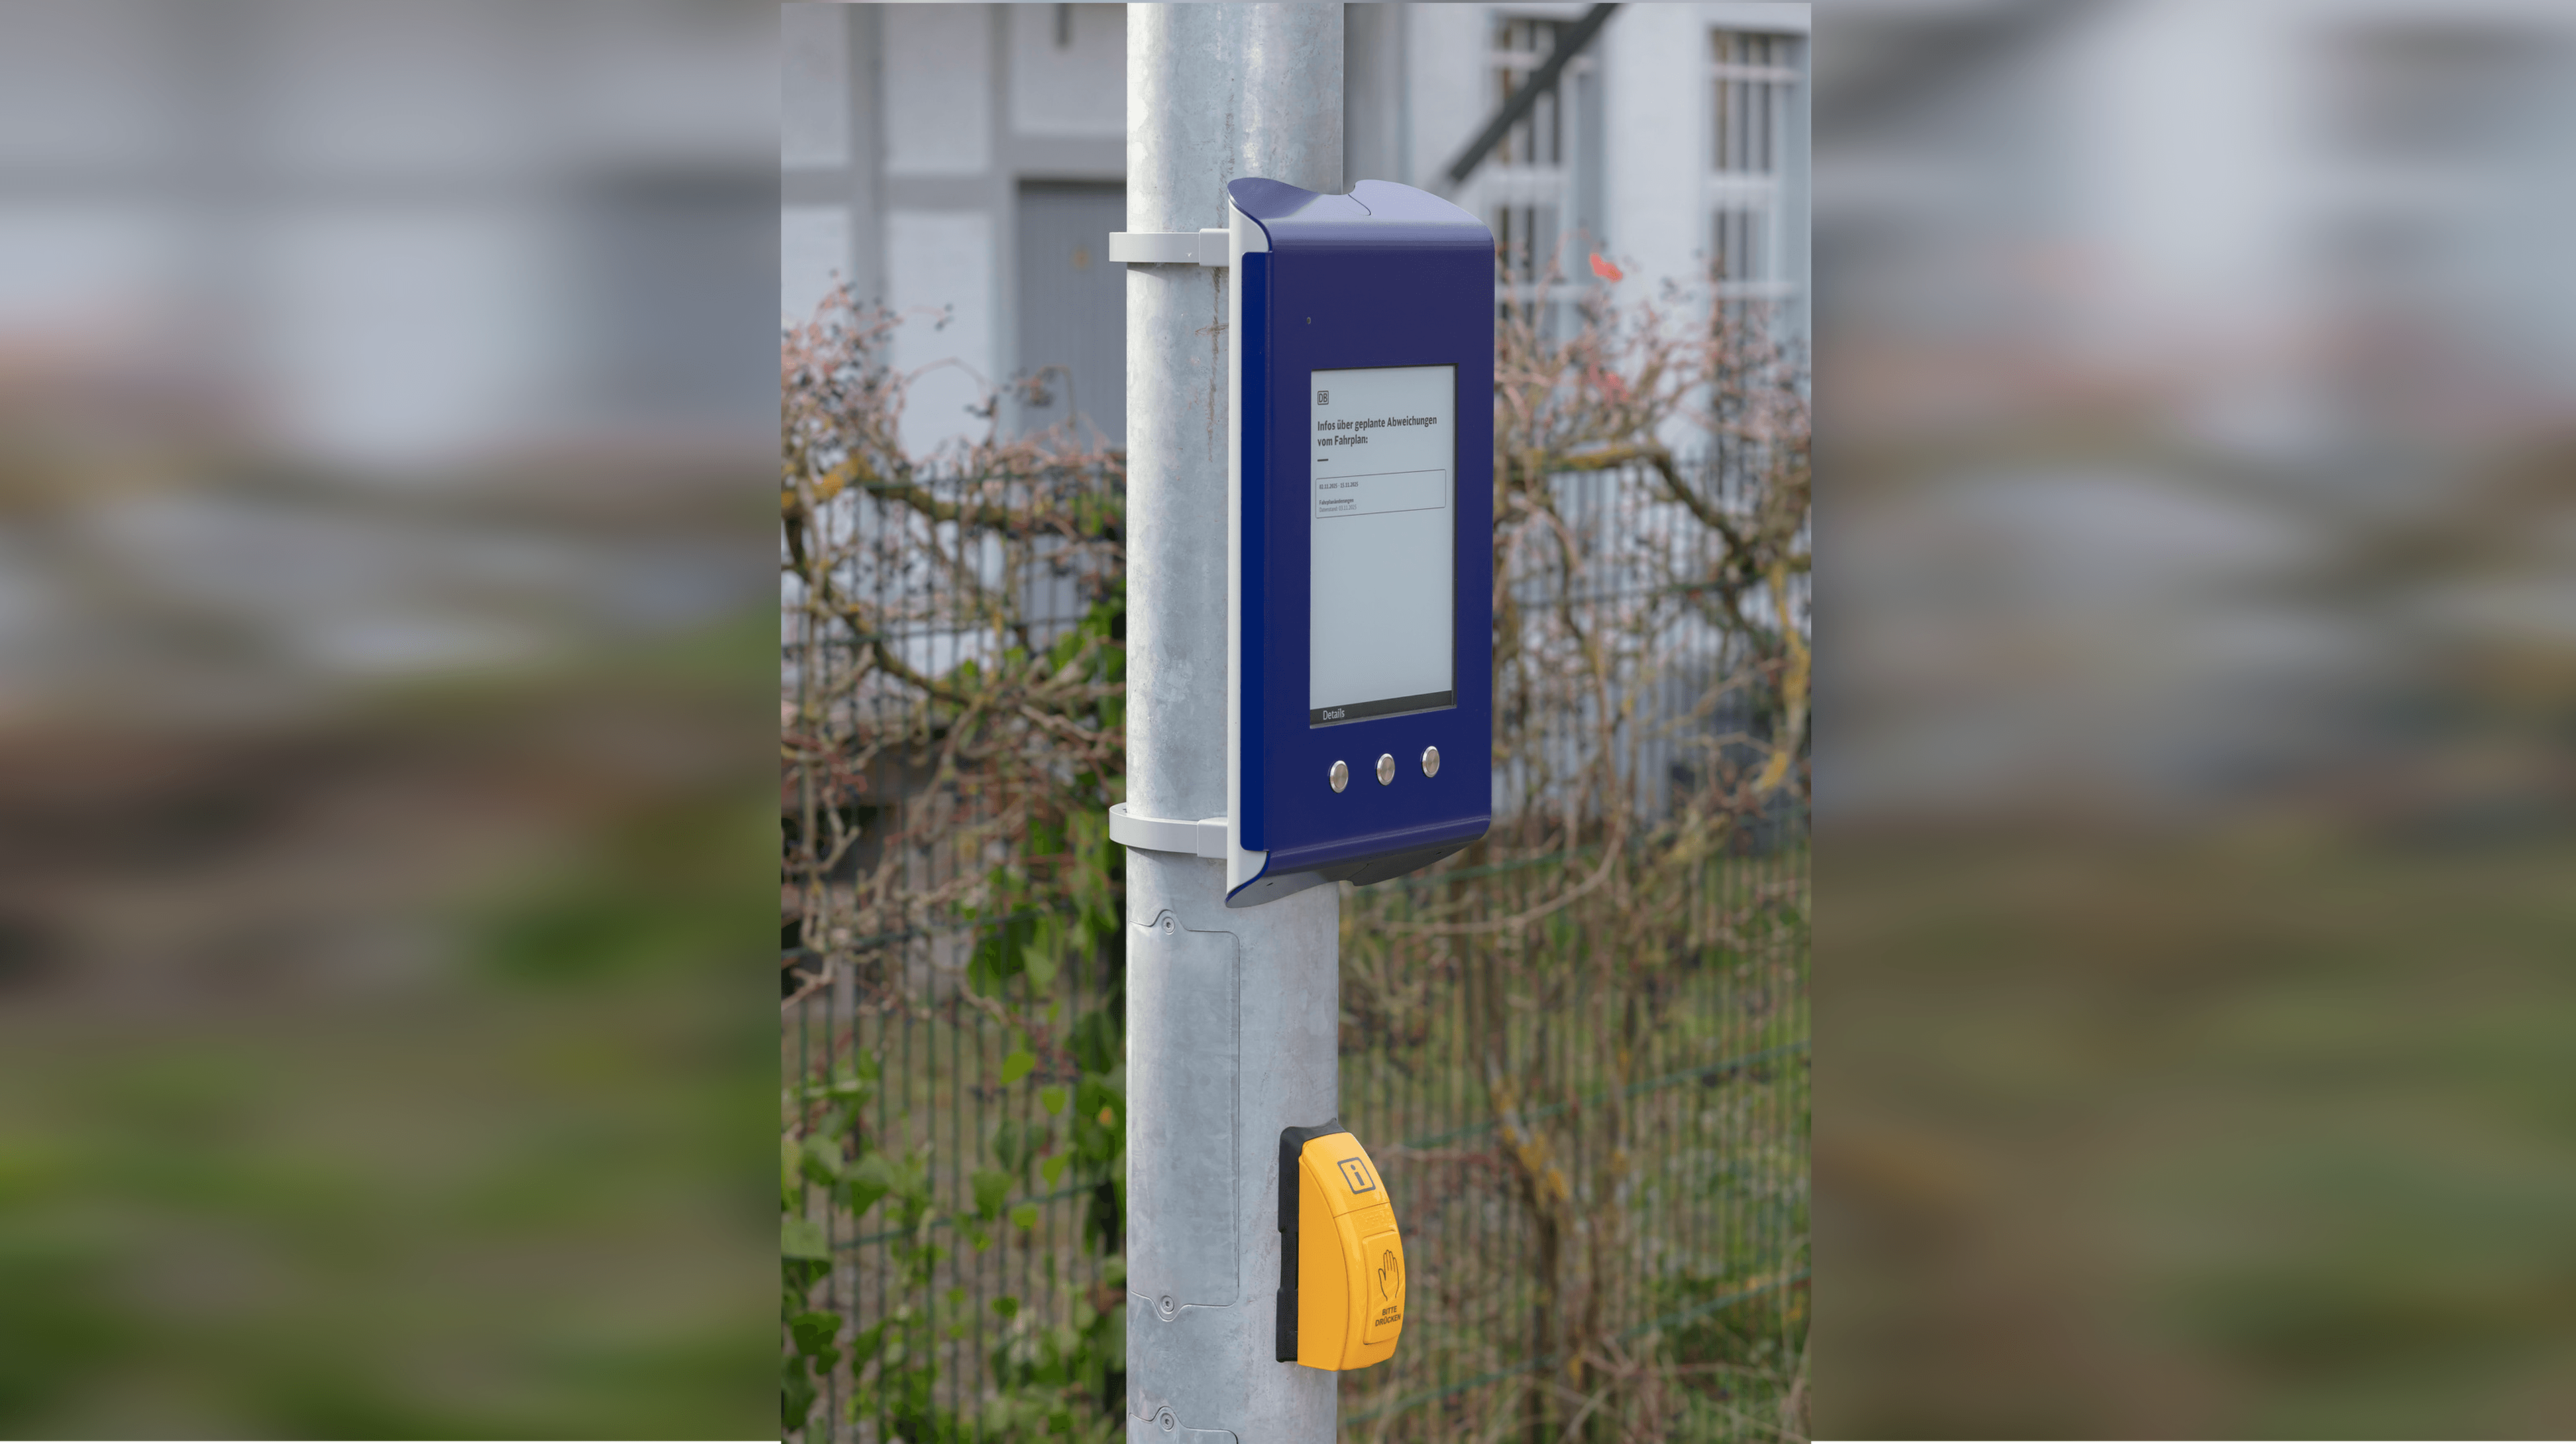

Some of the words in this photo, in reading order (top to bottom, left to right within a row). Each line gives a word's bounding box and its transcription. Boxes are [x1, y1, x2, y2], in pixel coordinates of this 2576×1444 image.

[1319, 393, 1328, 402] DB
[1318, 421, 1336, 431] Infos
[1337, 420, 1353, 430] über
[1354, 419, 1385, 431] geplante
[1387, 416, 1437, 427] Abweichungen
[1318, 437, 1333, 446] vom
[1334, 434, 1368, 447] Fahrplan:
[1323, 708, 1345, 720] Details
[1382, 1305, 1397, 1316] BITTE
[1375, 1313, 1401, 1327] DRÜCKEN
